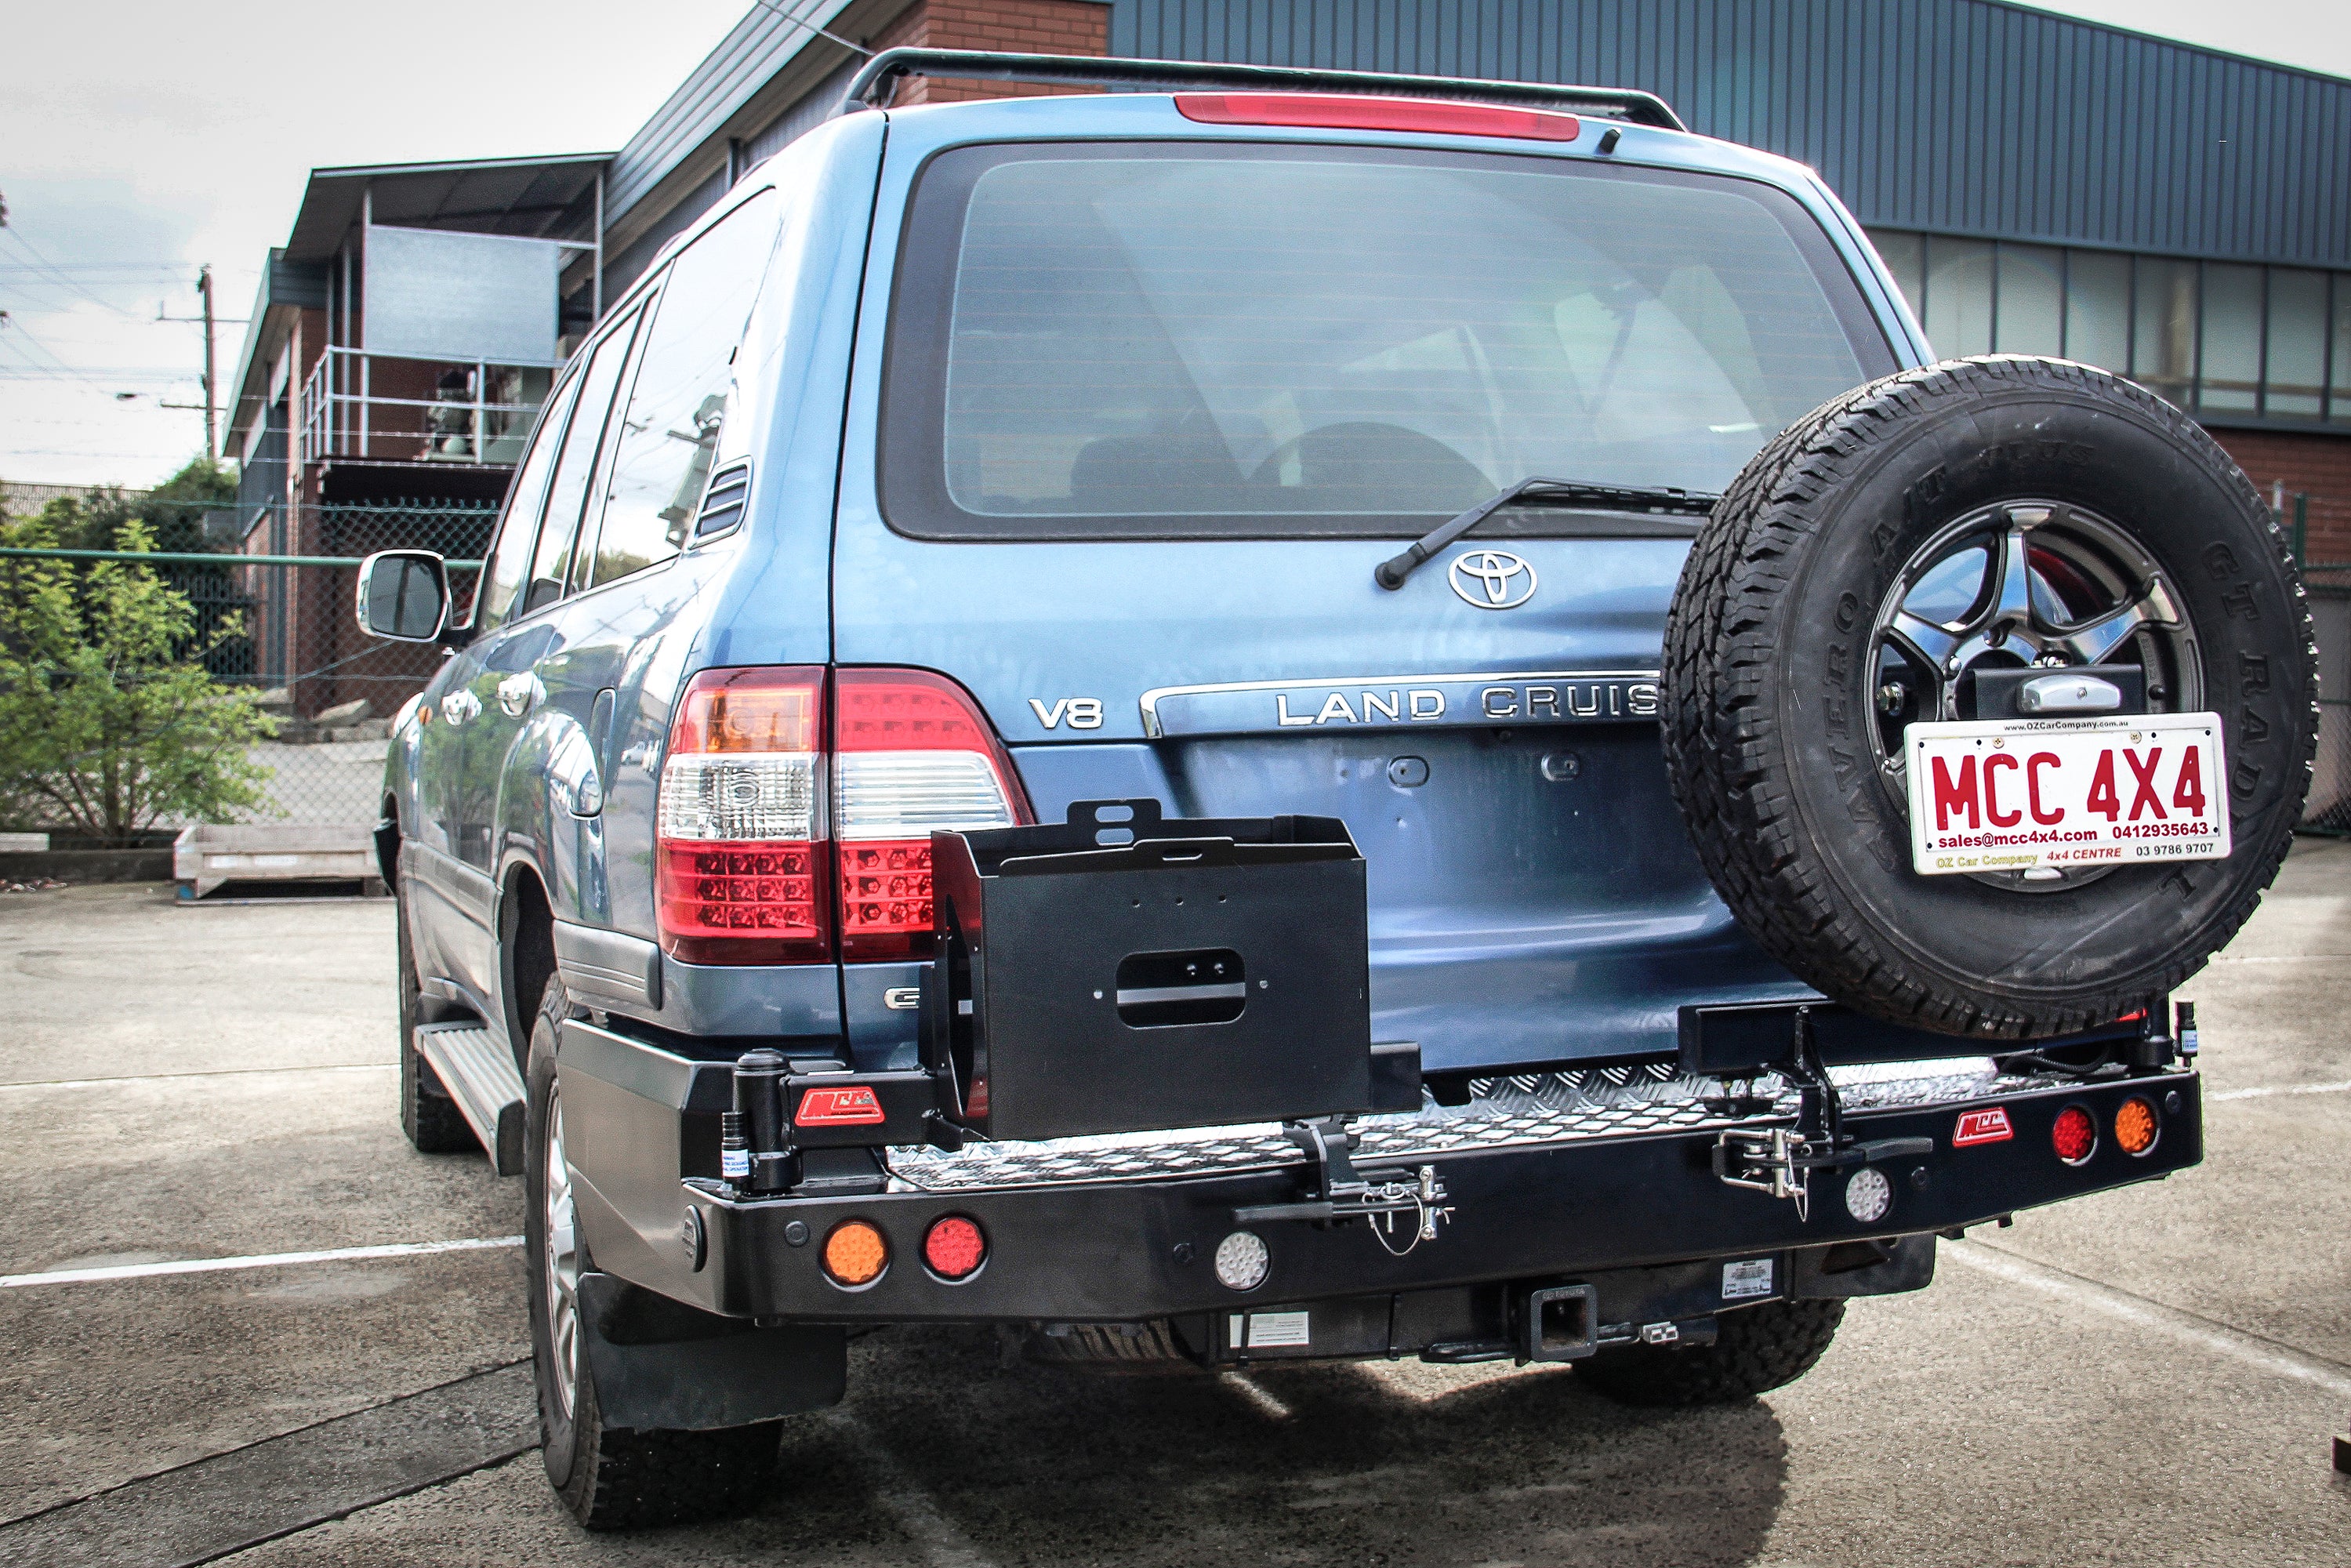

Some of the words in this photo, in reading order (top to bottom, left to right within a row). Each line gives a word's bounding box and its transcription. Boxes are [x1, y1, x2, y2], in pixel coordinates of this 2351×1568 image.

[2201, 540, 2260, 621] GT
[1028, 697, 1104, 729] V8
[1276, 689, 1446, 726] LAND
[1481, 684, 1659, 718] CRUIS
[2004, 720, 2128, 731] www.OZCarCompany.com.au
[1932, 751, 2065, 831] MCC
[2087, 745, 2206, 822] 4X4
[1938, 829, 2098, 848] sales@mcc4x4.com
[2112, 822, 2209, 840] 0412935643
[1936, 856, 1954, 868] OZ
[1957, 856, 1978, 866] Car
[1982, 853, 2038, 866] Company
[2047, 850, 2069, 861] 4x4
[2073, 847, 2122, 860] CENTRE
[2136, 846, 2150, 857] 03
[2153, 844, 2182, 856] 9786
[2186, 842, 2214, 854] 9707
